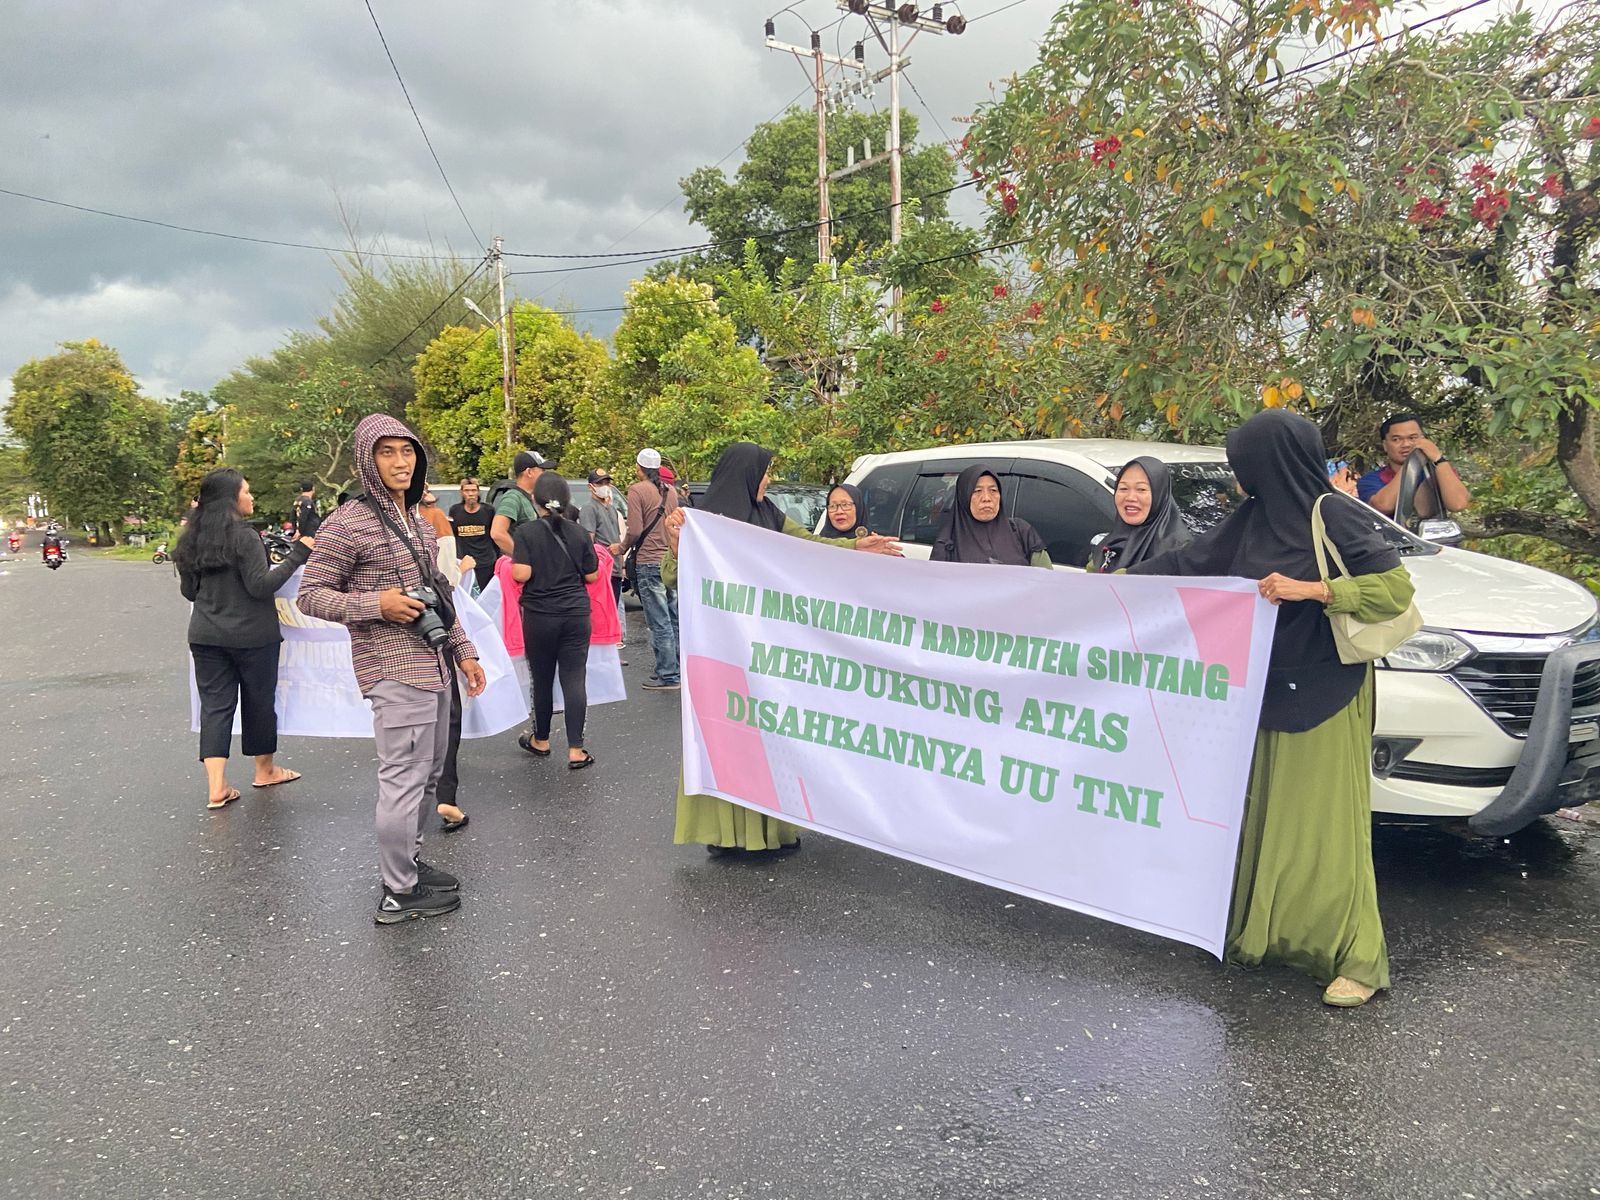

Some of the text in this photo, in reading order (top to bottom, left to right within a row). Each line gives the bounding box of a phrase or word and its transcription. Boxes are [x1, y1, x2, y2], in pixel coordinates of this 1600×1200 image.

[701, 577, 1229, 701] KAMI MASYARAKAT KABUPATEN SINTANG
[748, 641, 1129, 753] MENDUKUNG ATAS
[726, 690, 1164, 829] DISAHKANNYA UU TNI
